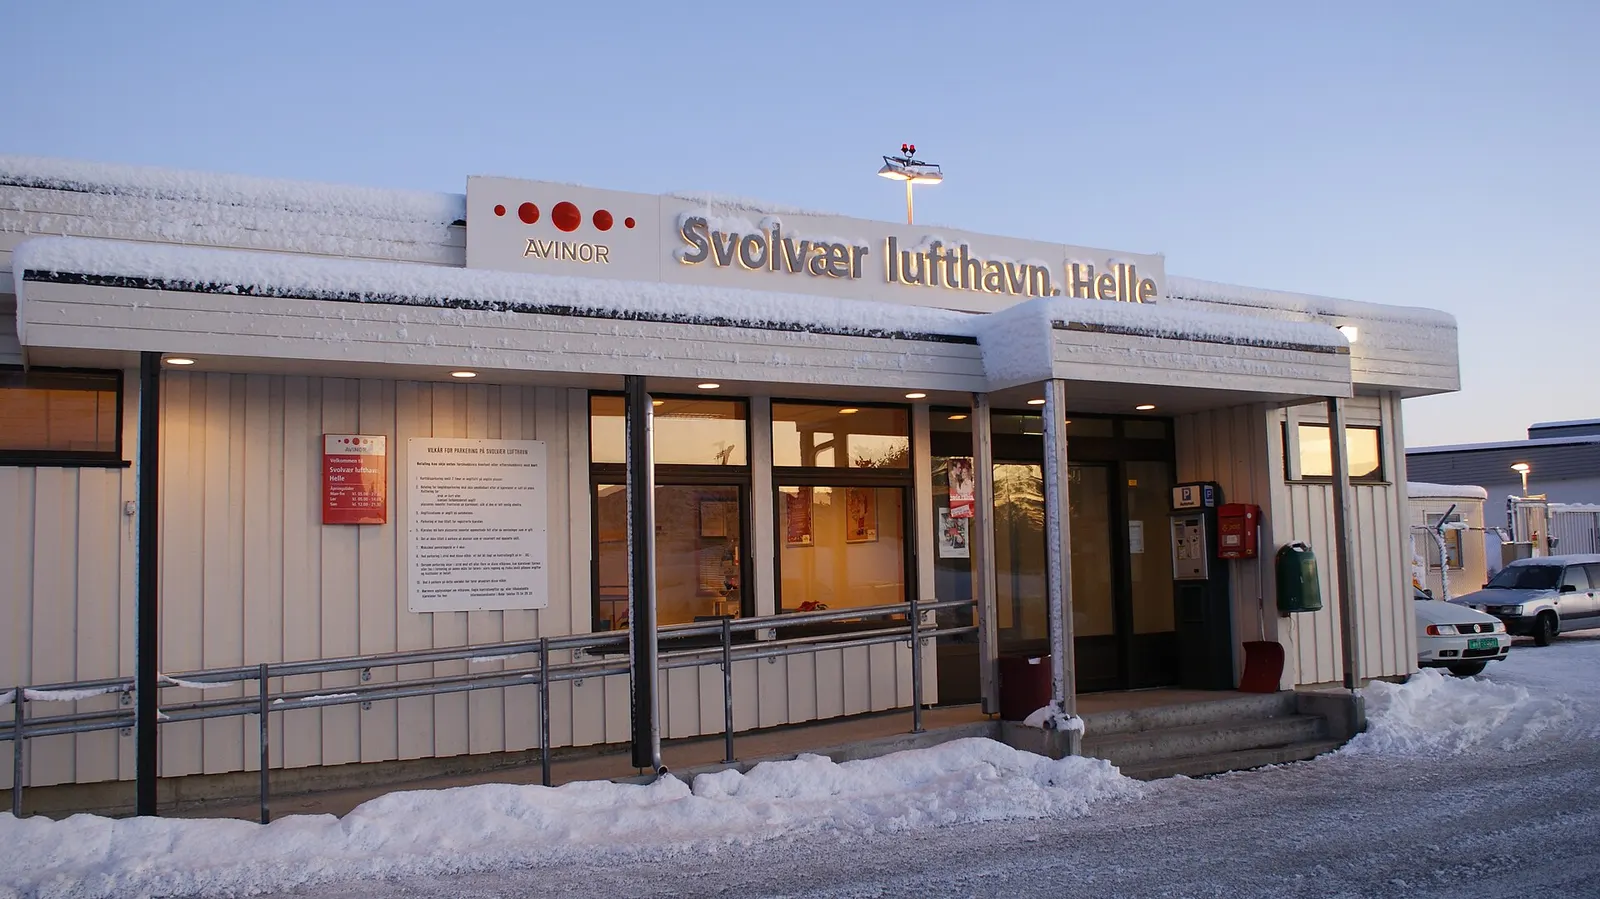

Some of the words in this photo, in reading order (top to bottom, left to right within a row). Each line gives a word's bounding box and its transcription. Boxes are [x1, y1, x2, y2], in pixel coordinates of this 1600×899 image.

[523, 238, 610, 264] AVINOR
[679, 215, 869, 279] Svolvær
[1067, 263, 1158, 305] Helle
